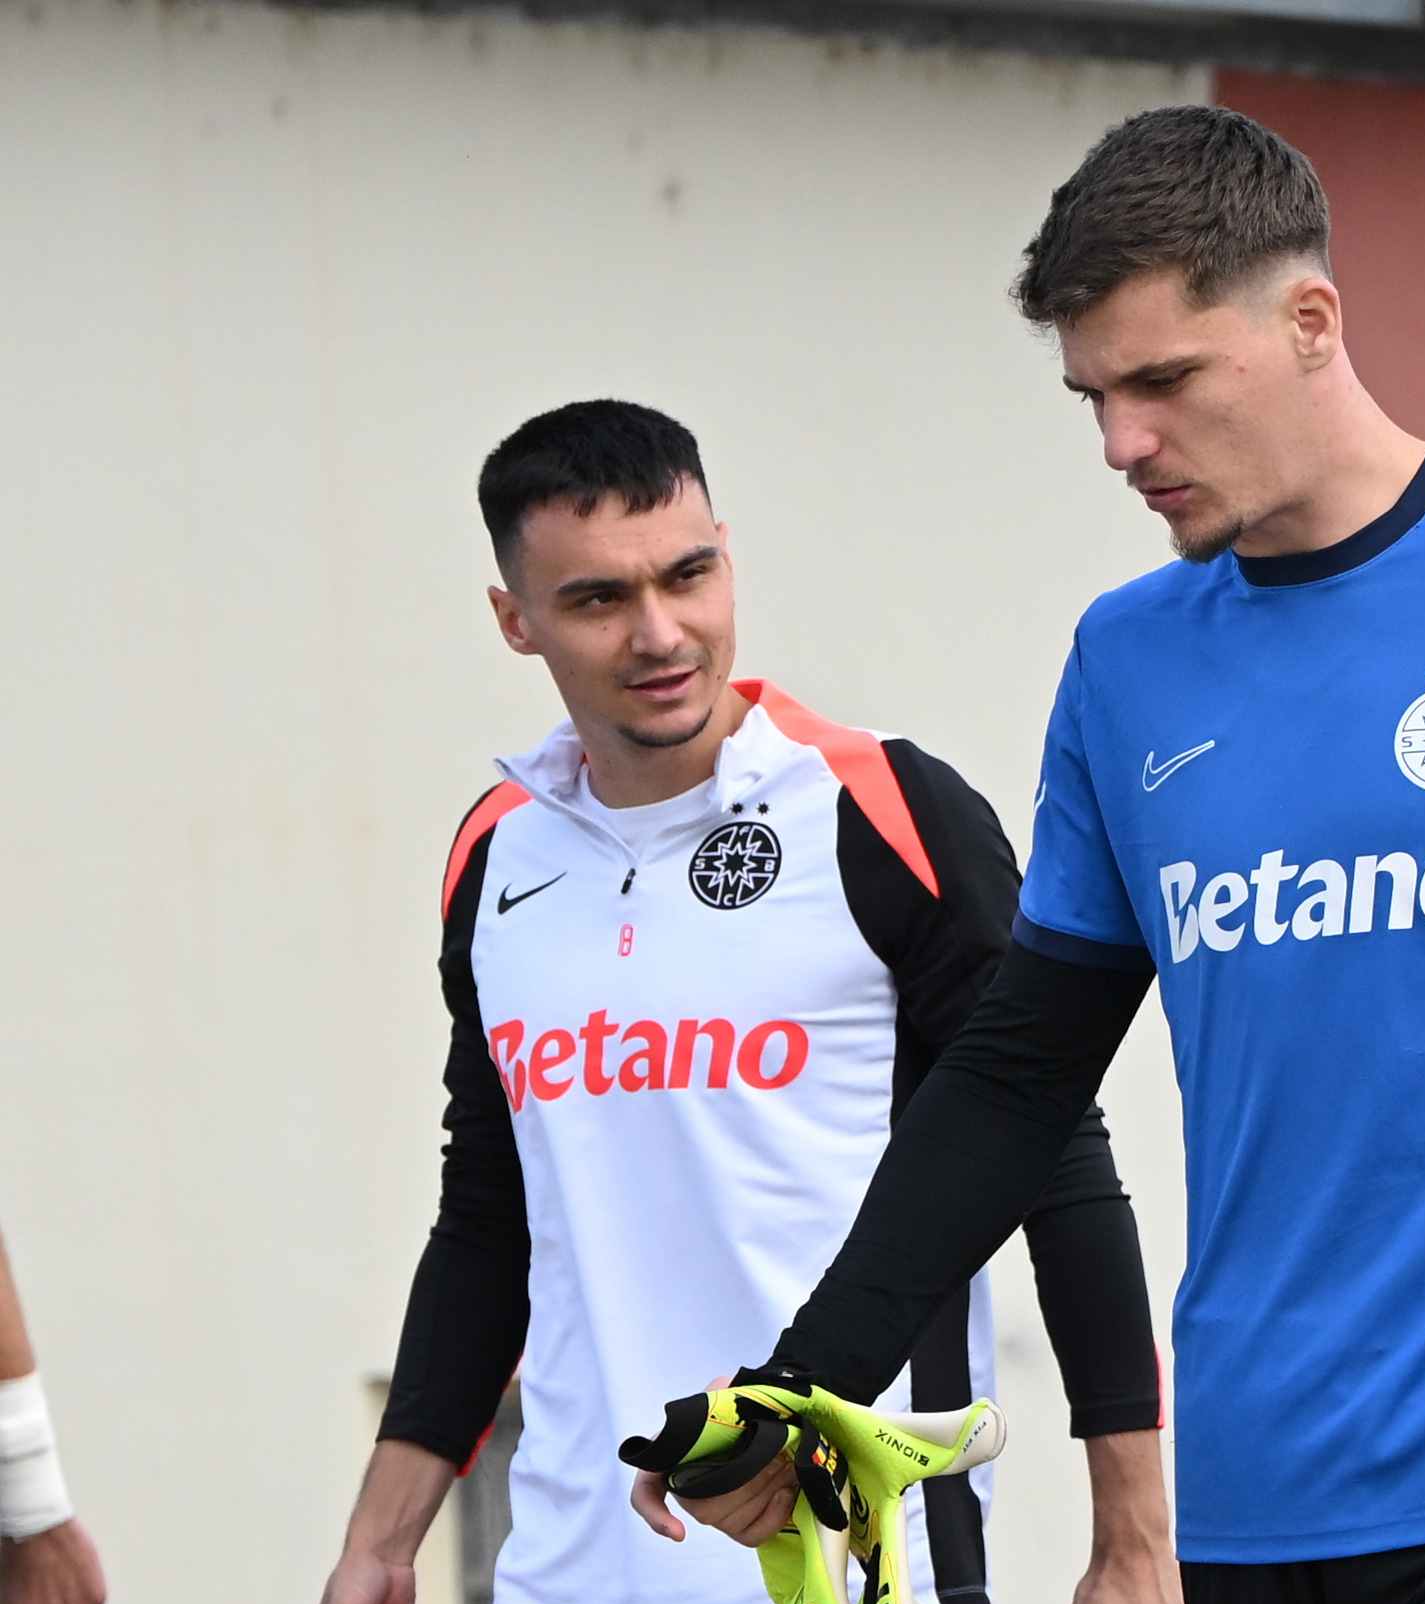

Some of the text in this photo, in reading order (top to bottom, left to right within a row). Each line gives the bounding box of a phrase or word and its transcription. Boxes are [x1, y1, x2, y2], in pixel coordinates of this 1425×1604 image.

[618, 923, 634, 957] 8
[489, 1009, 809, 1114] Betano
[875, 1428, 930, 1467] BIONIX
